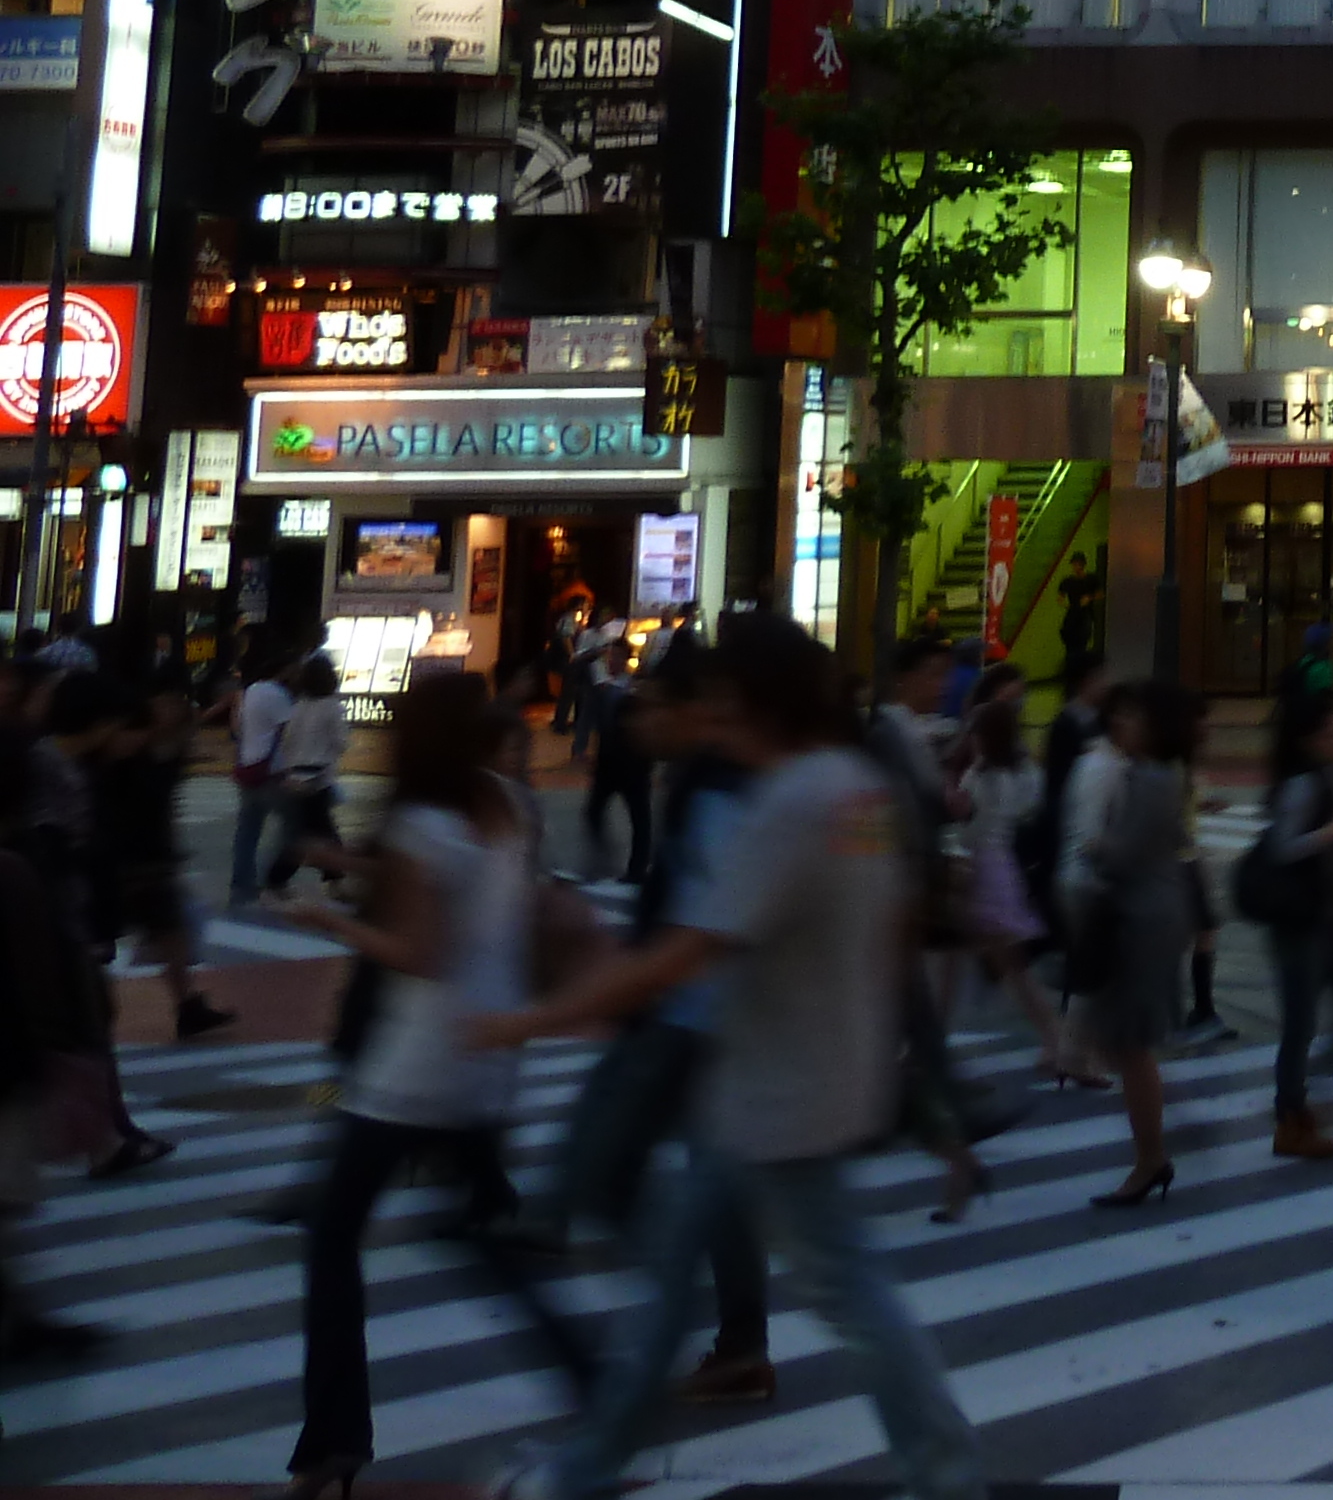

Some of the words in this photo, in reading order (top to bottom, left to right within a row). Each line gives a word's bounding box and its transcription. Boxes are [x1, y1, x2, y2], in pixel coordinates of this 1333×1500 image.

[533, 37, 578, 80] LOS
[583, 35, 661, 78] CABOS
[604, 173, 632, 204] 2F
[336, 422, 478, 460] PASELA
[490, 421, 664, 459] RESORTS
[1299, 452, 1330, 464] BANK
